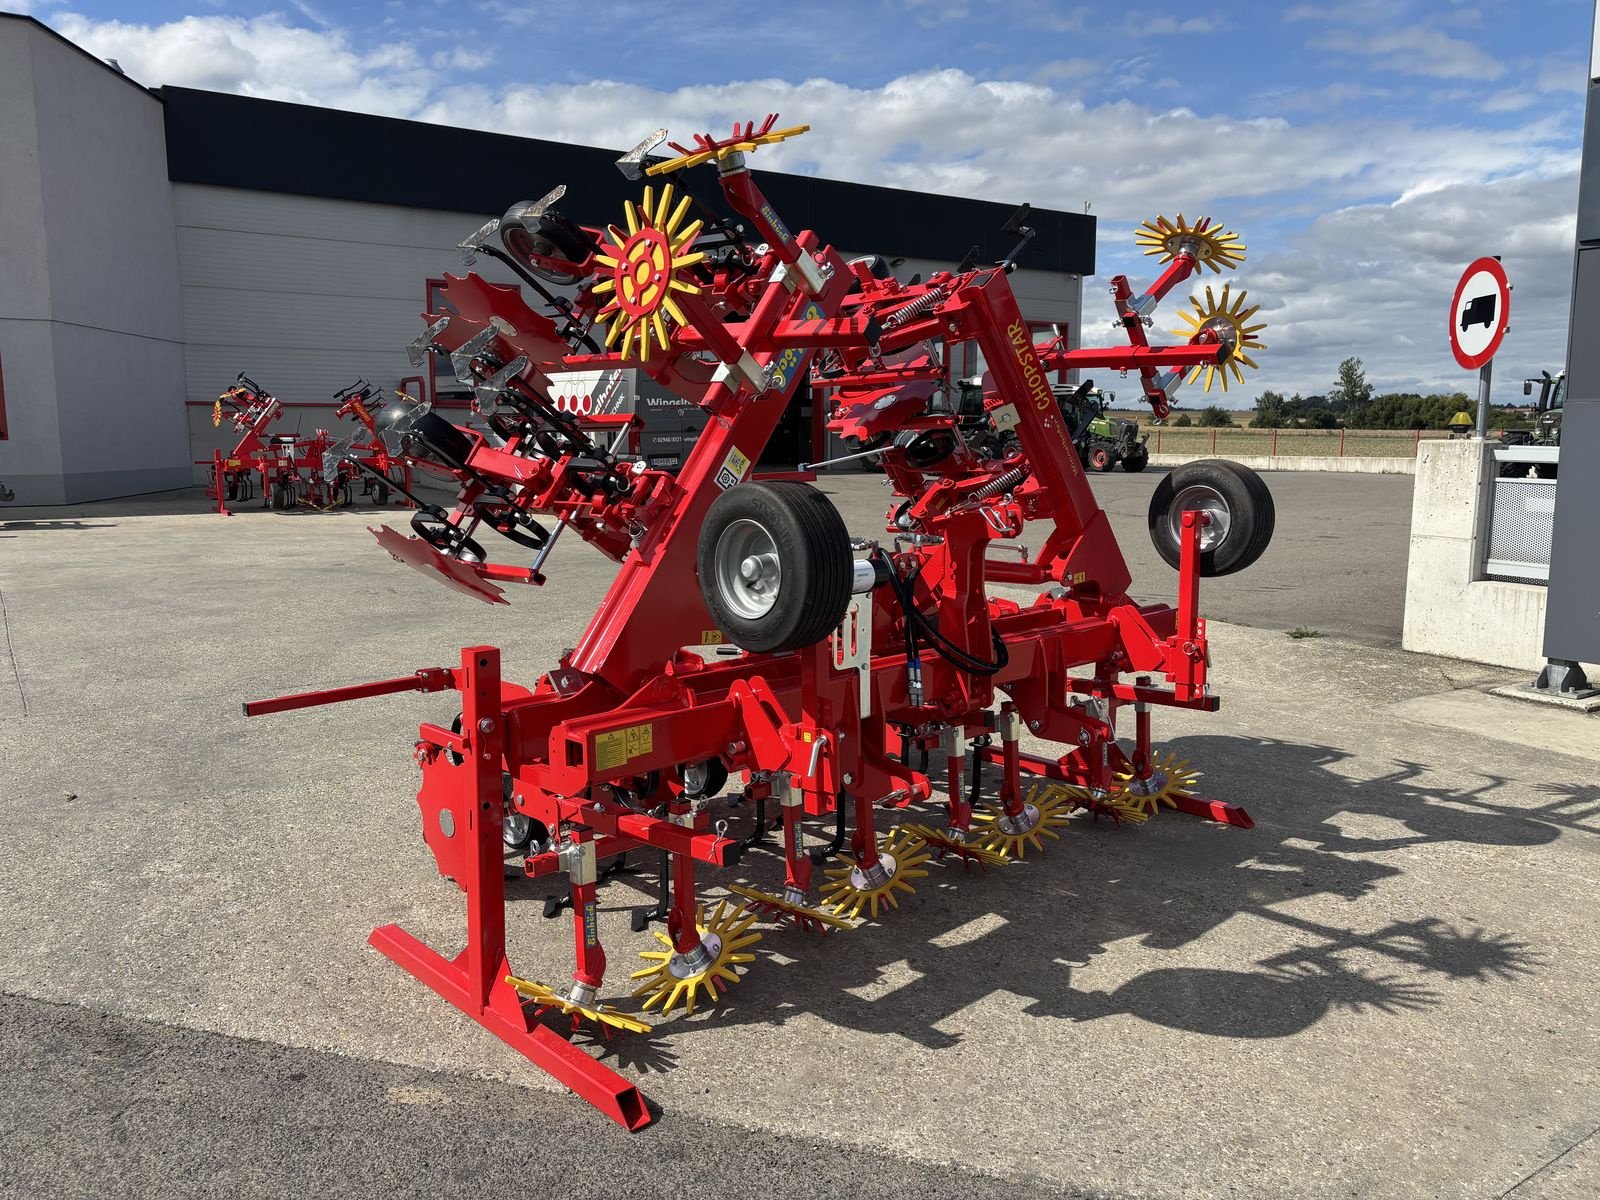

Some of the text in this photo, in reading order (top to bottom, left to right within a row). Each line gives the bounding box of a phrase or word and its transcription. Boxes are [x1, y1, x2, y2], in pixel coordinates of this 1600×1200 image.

[762, 205, 789, 242] Einböck
[1007, 318, 1050, 410] CHOPSTAR
[585, 904, 595, 945] Einböck
